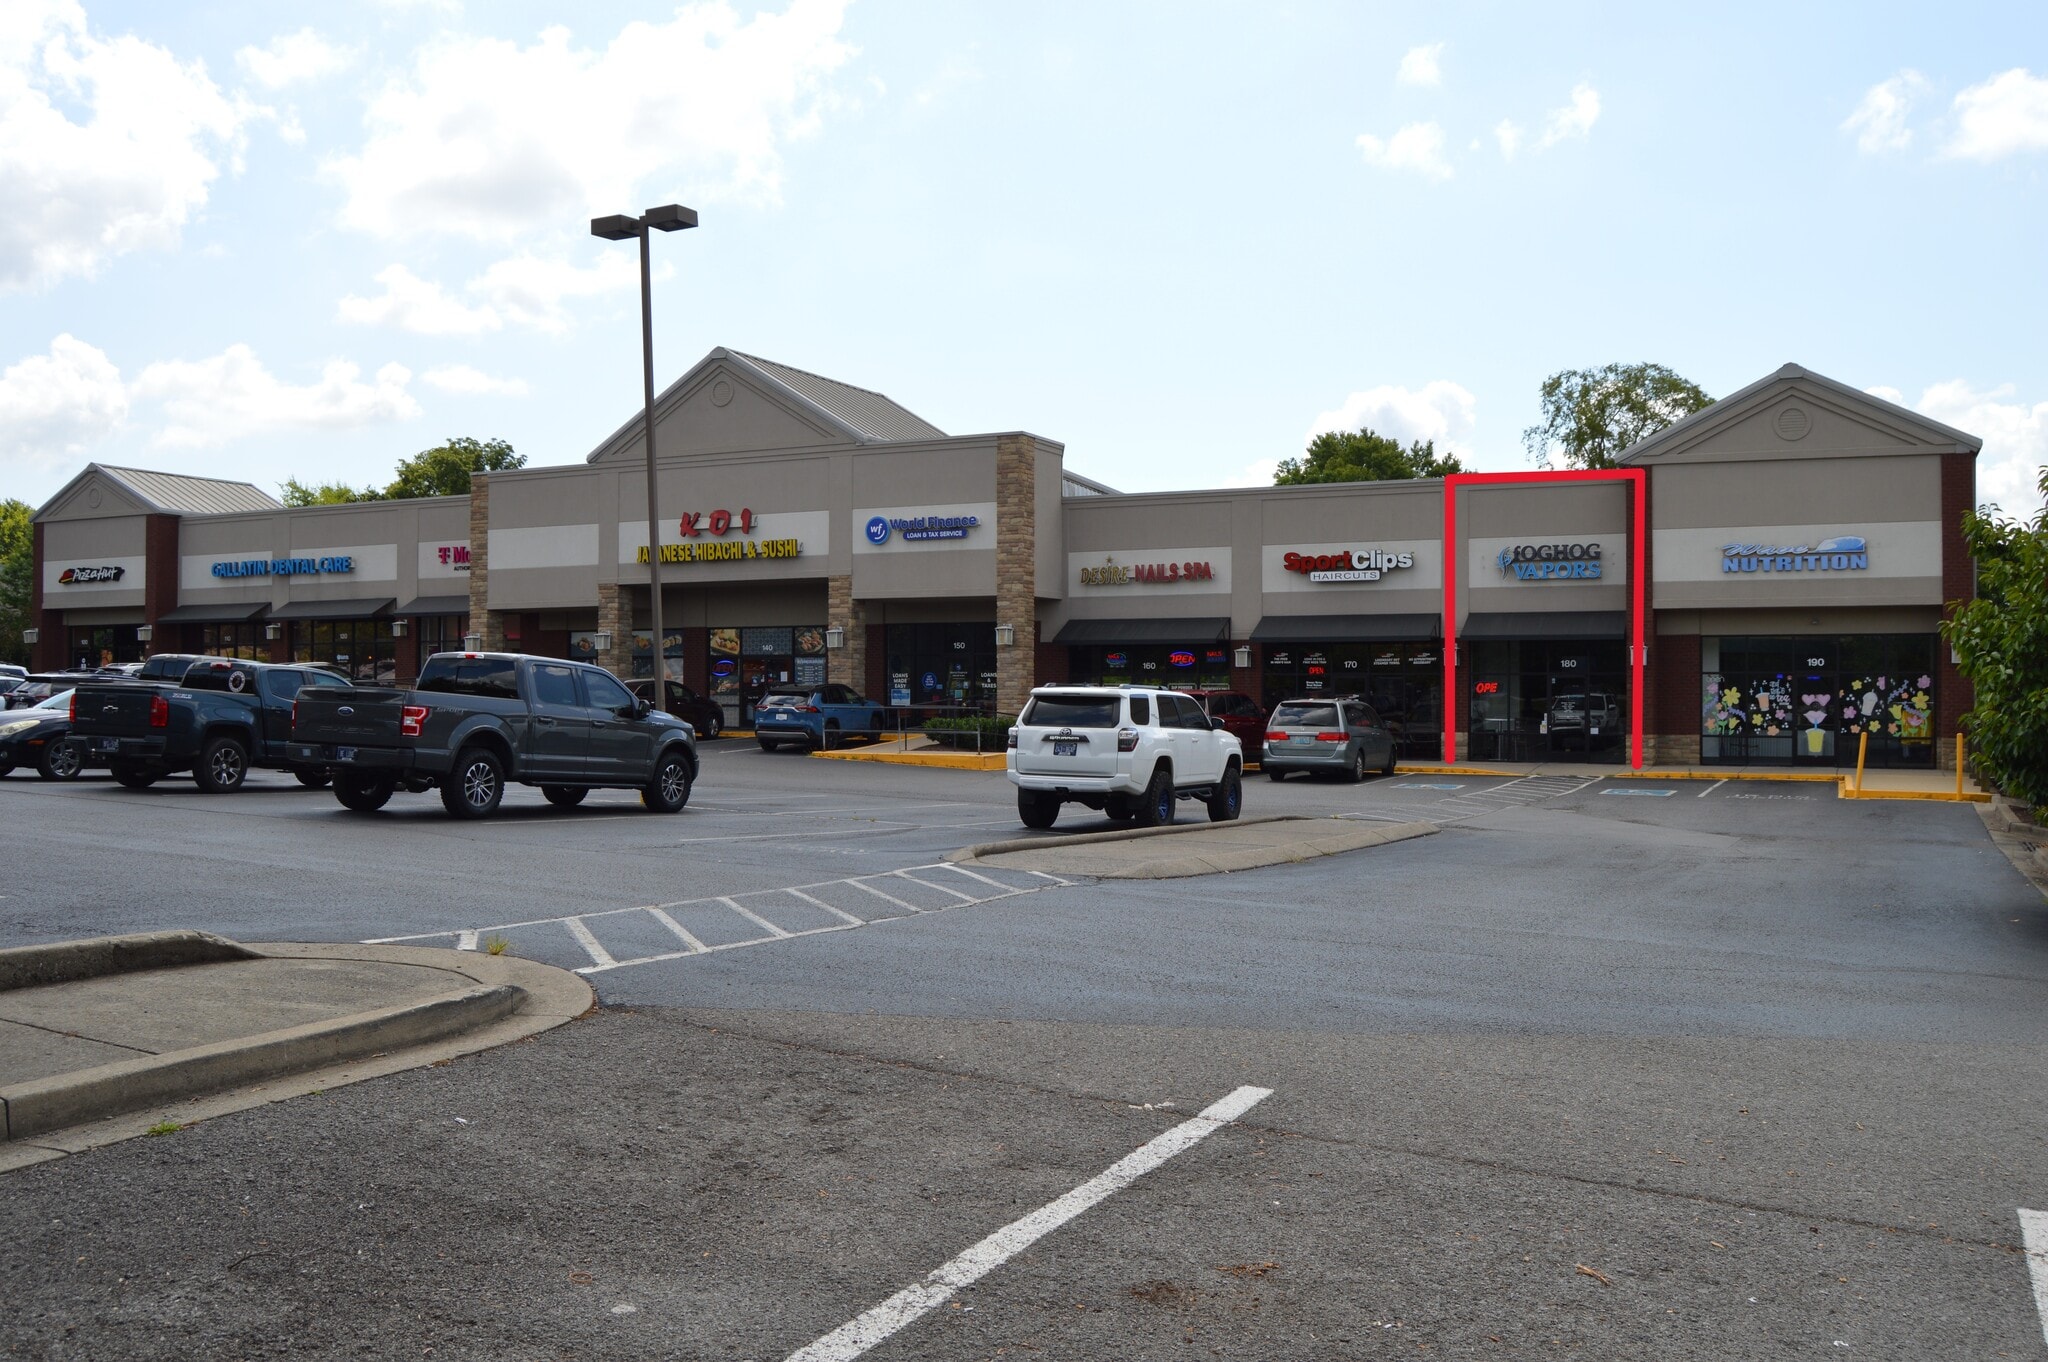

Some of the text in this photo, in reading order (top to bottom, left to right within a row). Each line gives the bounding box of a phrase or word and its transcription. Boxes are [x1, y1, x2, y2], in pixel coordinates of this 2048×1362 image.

[680, 508, 752, 537] KOI
[890, 516, 977, 530] World Finance
[637, 539, 797, 564] JAANESE HIBACHI & SUSHI
[211, 556, 351, 577] GALLATIN DENTAL CARE
[1512, 561, 1601, 580] VAPORS
[1723, 554, 1867, 573] NUTRITION
[1080, 562, 1212, 584] DESIRE NAILS SPA
[1312, 572, 1377, 581] HAIRCUTS
[1142, 662, 1156, 670] 160
[1344, 661, 1358, 669] 170
[1560, 659, 1576, 668] 180
[1807, 658, 1825, 666] 190
[1308, 666, 1324, 675] OPEN
